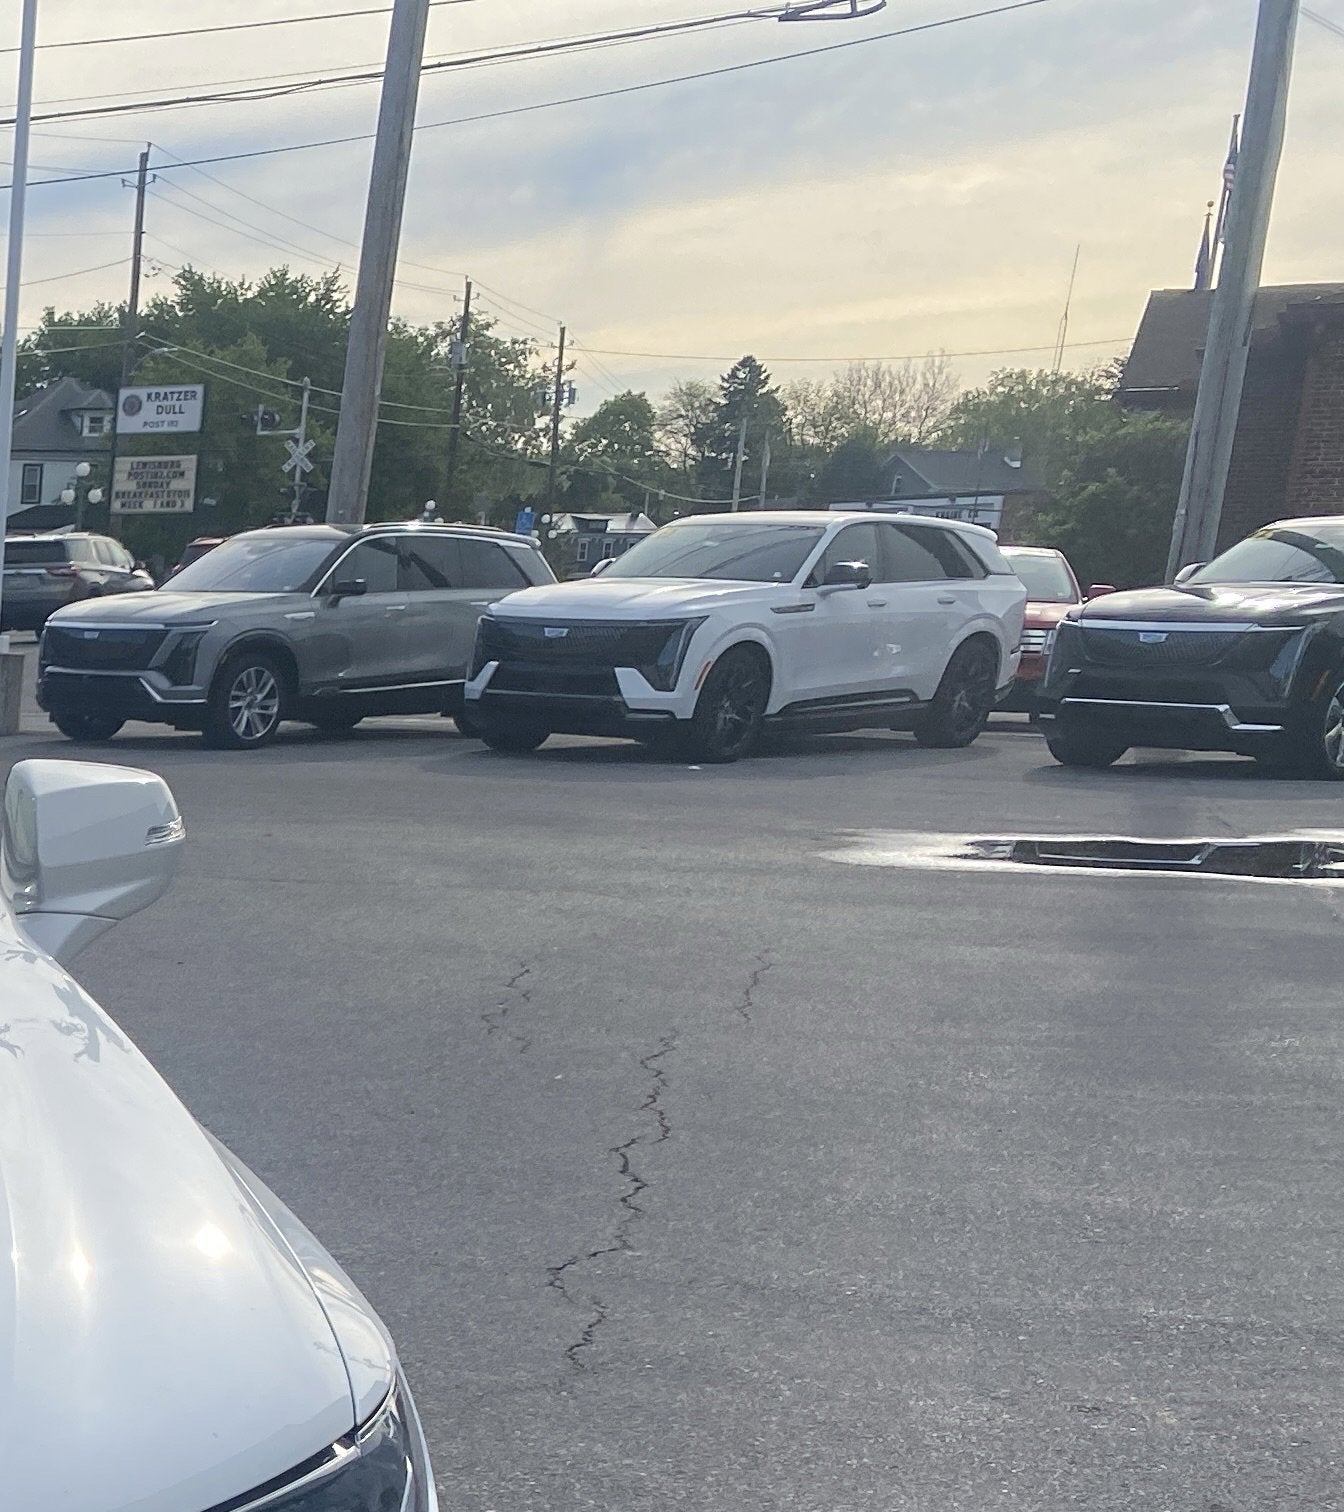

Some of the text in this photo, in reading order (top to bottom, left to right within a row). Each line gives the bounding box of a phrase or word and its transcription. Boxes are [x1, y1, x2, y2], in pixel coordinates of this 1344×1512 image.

[146, 391, 198, 402] KRATZER
[156, 404, 185, 415] DULL
[142, 420, 165, 429] POST
[135, 480, 171, 490] SUNDAY
[120, 500, 144, 510] WEEK
